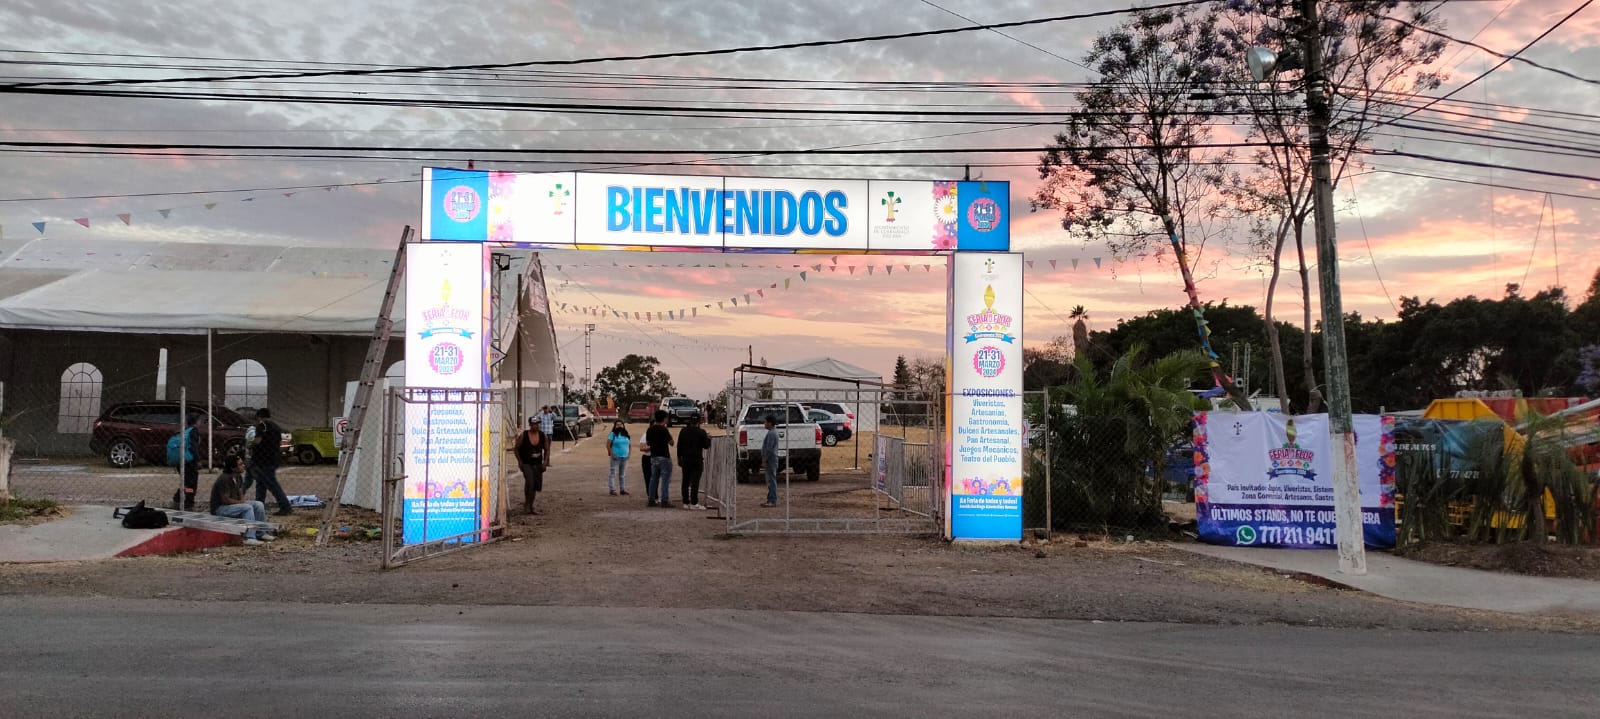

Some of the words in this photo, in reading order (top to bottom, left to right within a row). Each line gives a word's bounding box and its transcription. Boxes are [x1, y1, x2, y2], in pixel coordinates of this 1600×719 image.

[606, 185, 849, 237] BIENVENIDOS
[434, 346, 458, 356] 21-31
[978, 350, 1000, 360] 21-31
[434, 356, 458, 364] MARZO
[979, 360, 1000, 368] MARZO
[972, 400, 1005, 408] Viveristas,
[958, 426, 979, 434] Dulces
[981, 427, 1020, 436] Artesanales,
[959, 446, 982, 455] Juegos
[1268, 448, 1289, 461] FERIA
[961, 455, 981, 463] Teatro
[1211, 506, 1252, 521] ÚLTIMOS
[1254, 509, 1289, 523] STANDS,
[1291, 510, 1303, 522] NO
[1305, 511, 1316, 522] TE
[1318, 511, 1336, 524] QUE
[1362, 512, 1381, 524] ERA
[1259, 526, 1280, 543] 777
[1283, 526, 1303, 544] 211
[1306, 527, 1336, 545] 9411
